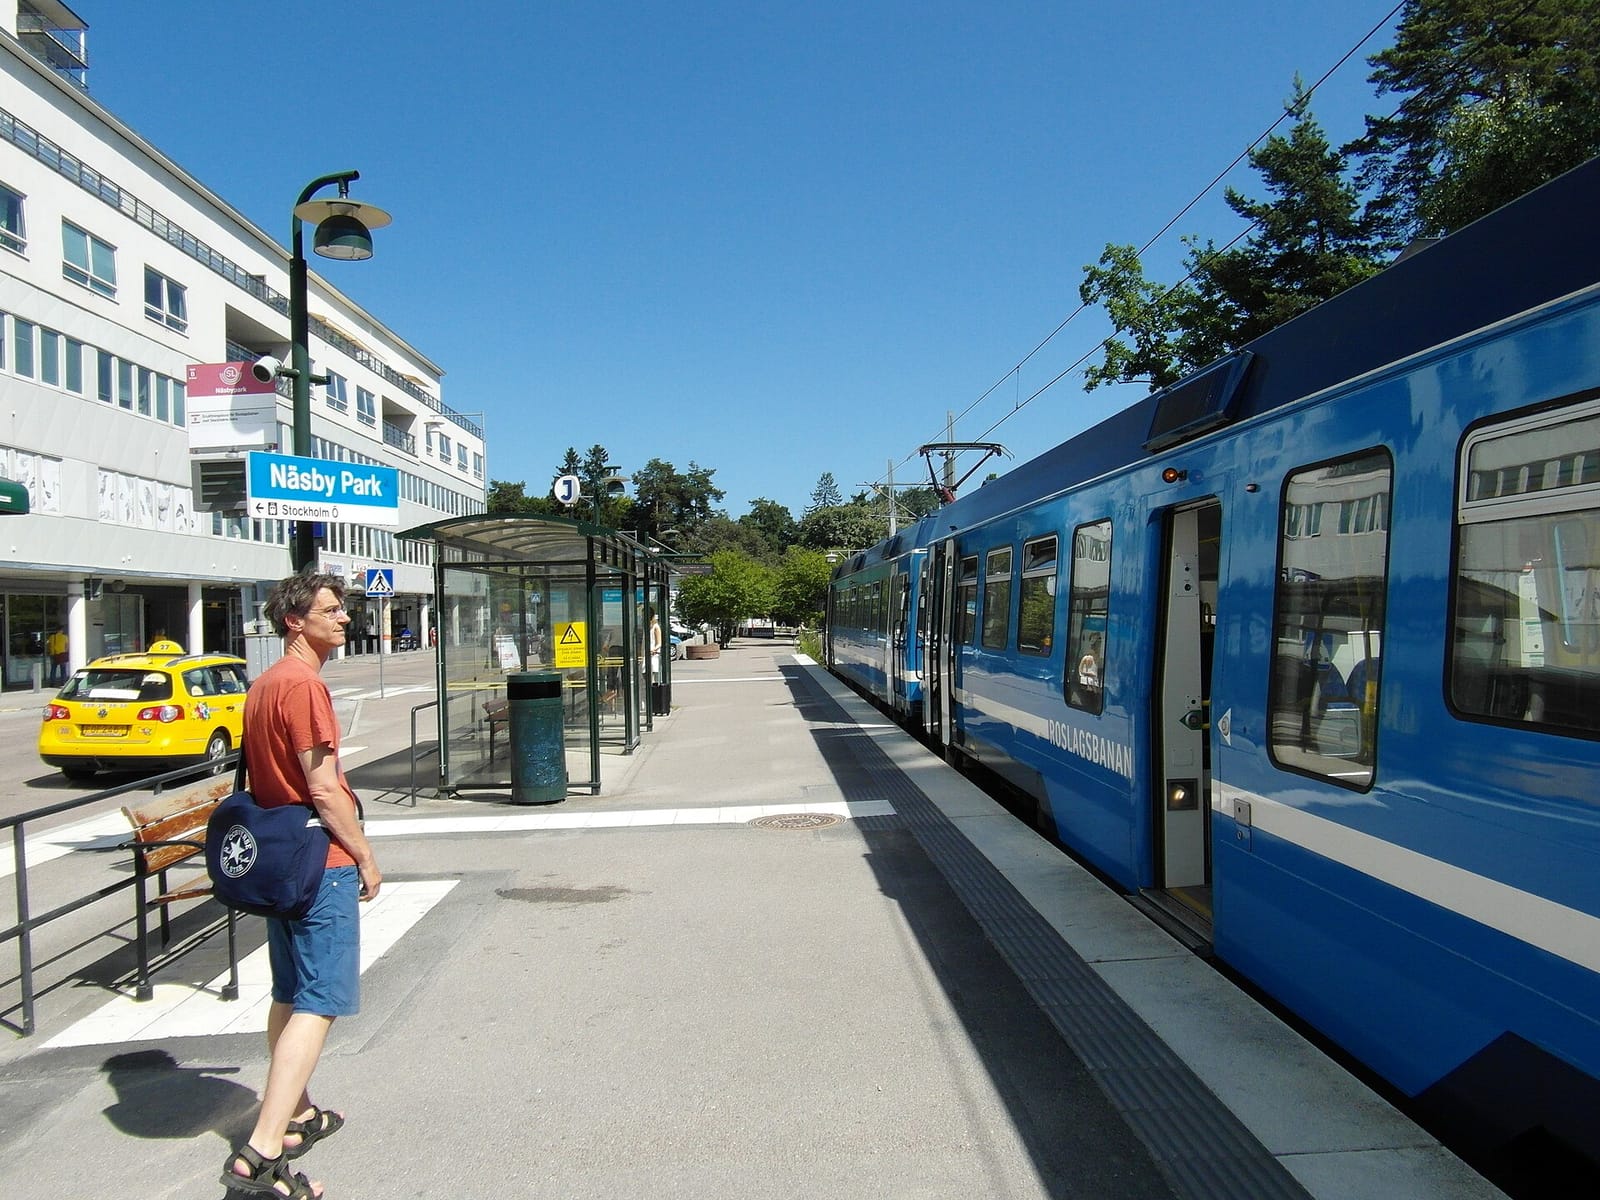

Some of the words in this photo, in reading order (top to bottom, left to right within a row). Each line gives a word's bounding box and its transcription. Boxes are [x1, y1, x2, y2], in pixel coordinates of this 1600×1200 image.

[215, 387, 247, 395] Näsbypark
[270, 463, 336, 498] Näsby
[341, 471, 383, 497] Park
[561, 479, 572, 501] J
[282, 505, 330, 517] Stockholm
[331, 505, 339, 518] Ö
[1049, 719, 1132, 779] ROSLAGSBANAN
